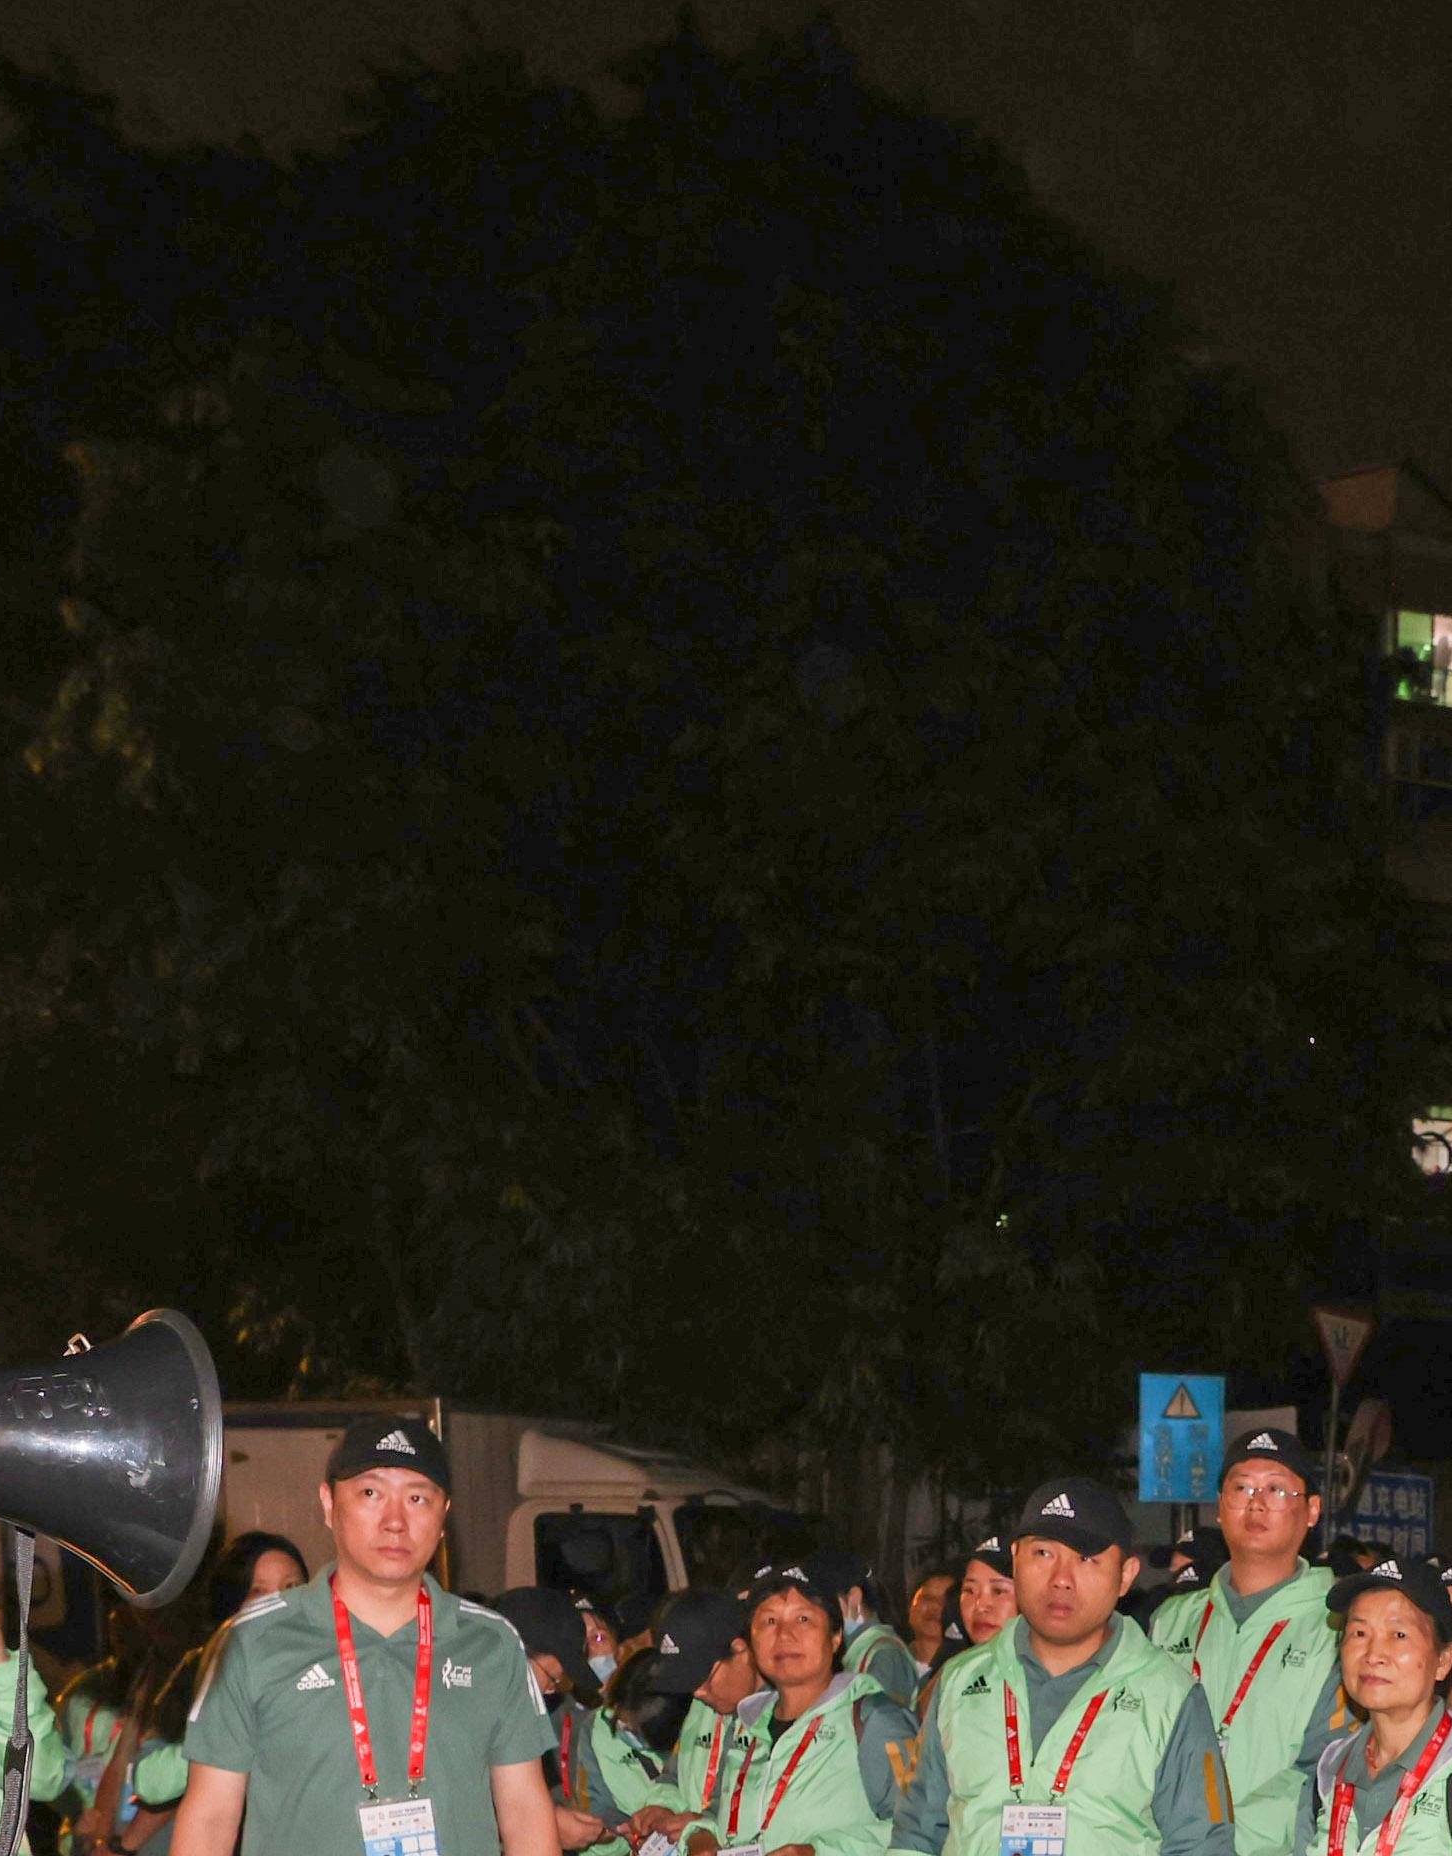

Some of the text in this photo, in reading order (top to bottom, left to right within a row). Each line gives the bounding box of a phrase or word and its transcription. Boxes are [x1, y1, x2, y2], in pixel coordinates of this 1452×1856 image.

[376, 1440, 416, 1456] adidas
[1041, 1507, 1075, 1519] adidas
[297, 1678, 335, 1691] adidas
